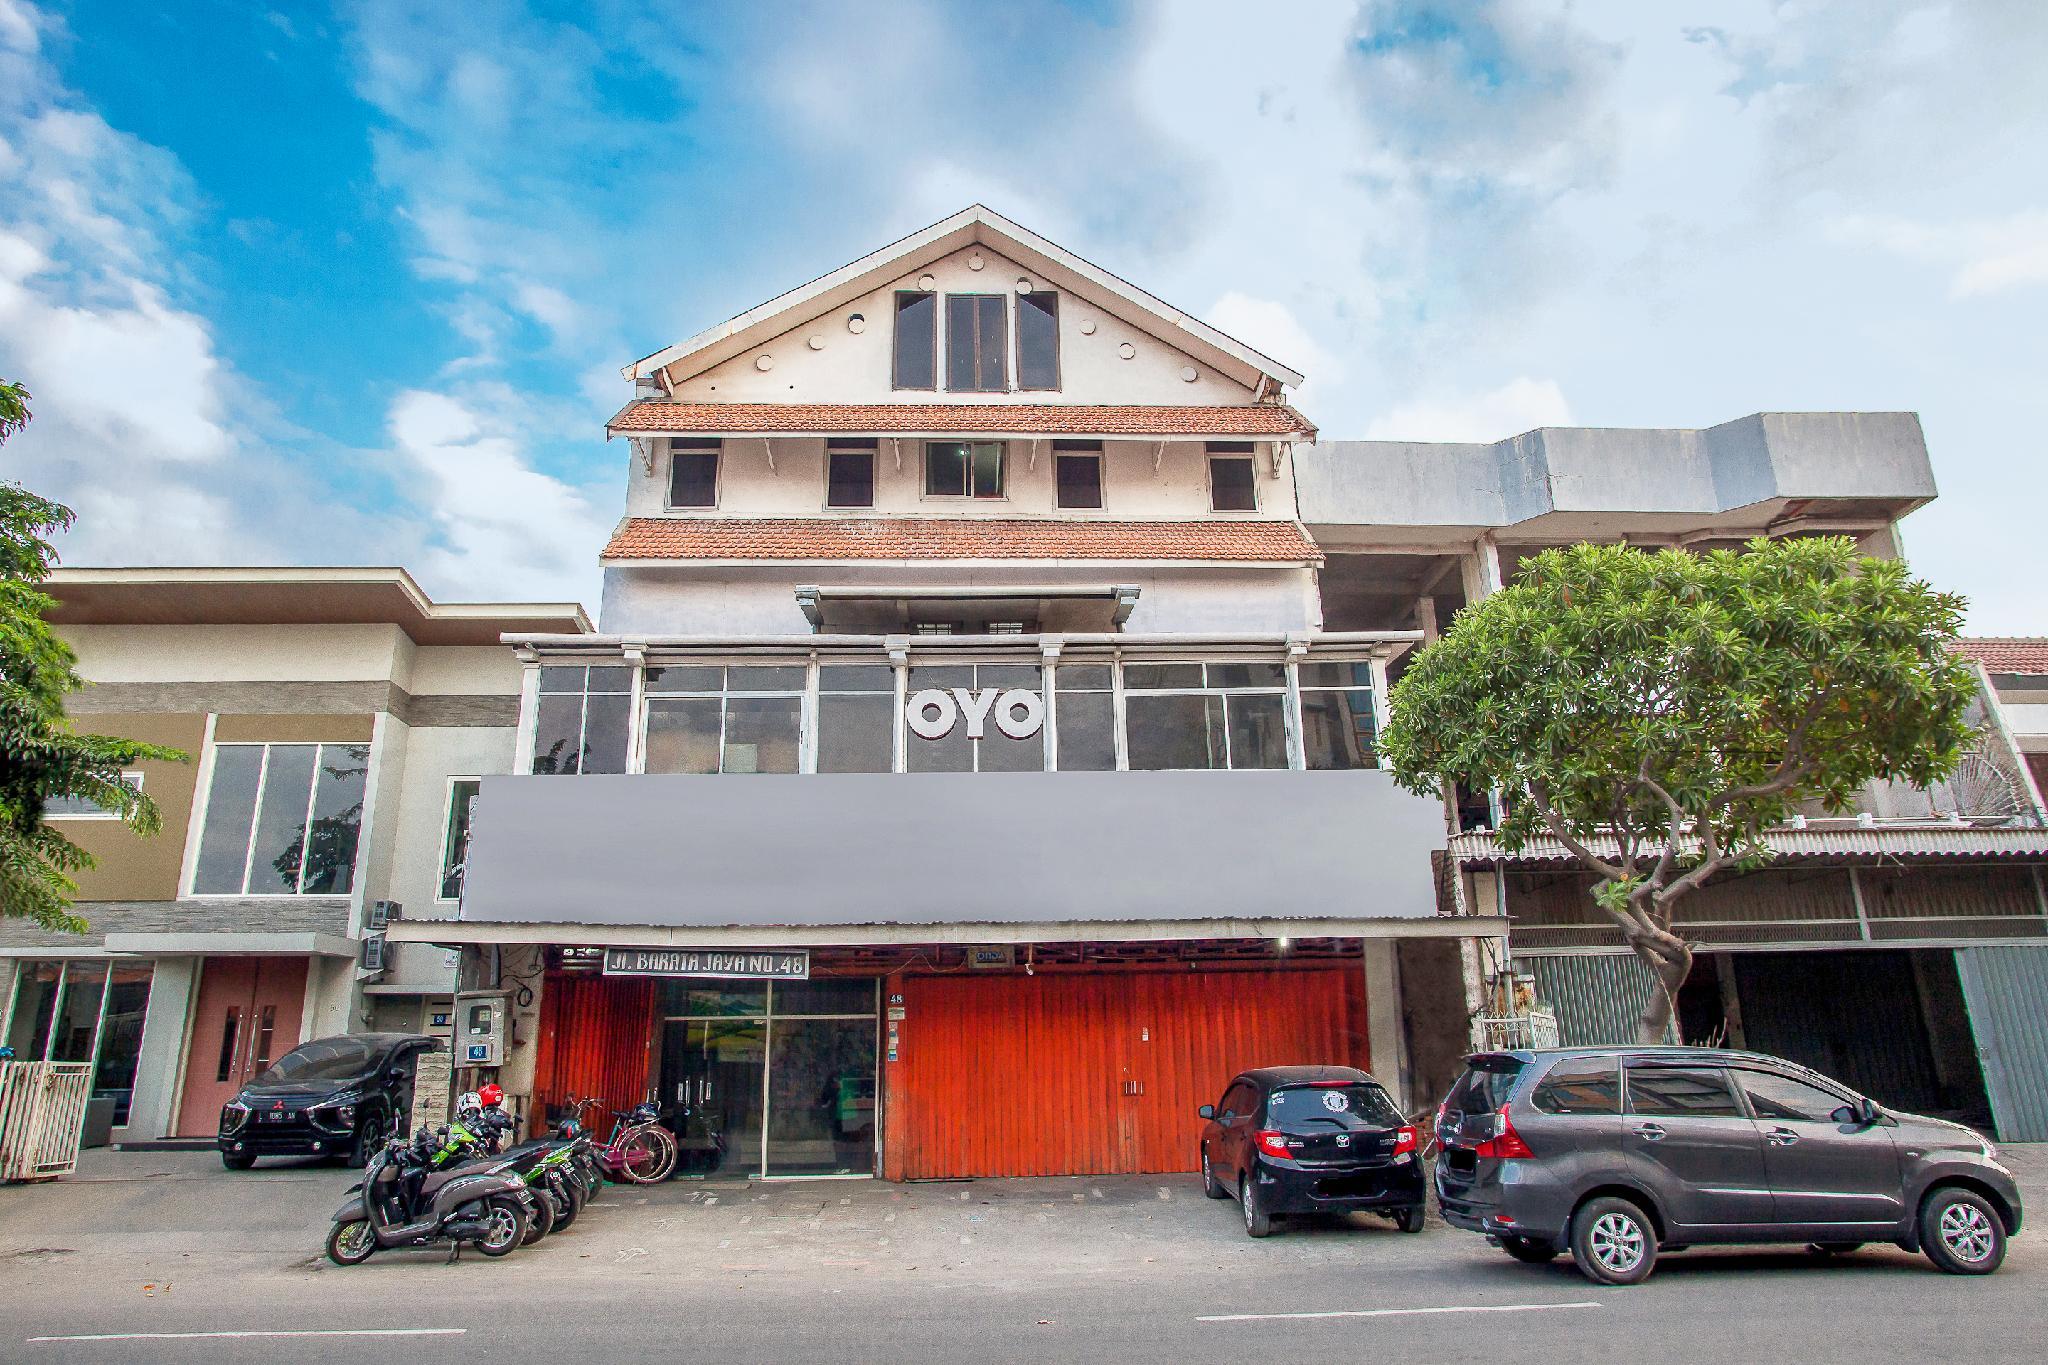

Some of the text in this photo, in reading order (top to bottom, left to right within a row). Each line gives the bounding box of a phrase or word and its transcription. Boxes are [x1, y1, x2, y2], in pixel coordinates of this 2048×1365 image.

[906, 687, 1044, 740] OYO
[636, 952, 699, 971] BARATA
[702, 953, 745, 972] JAYA
[890, 994, 903, 1003] 48
